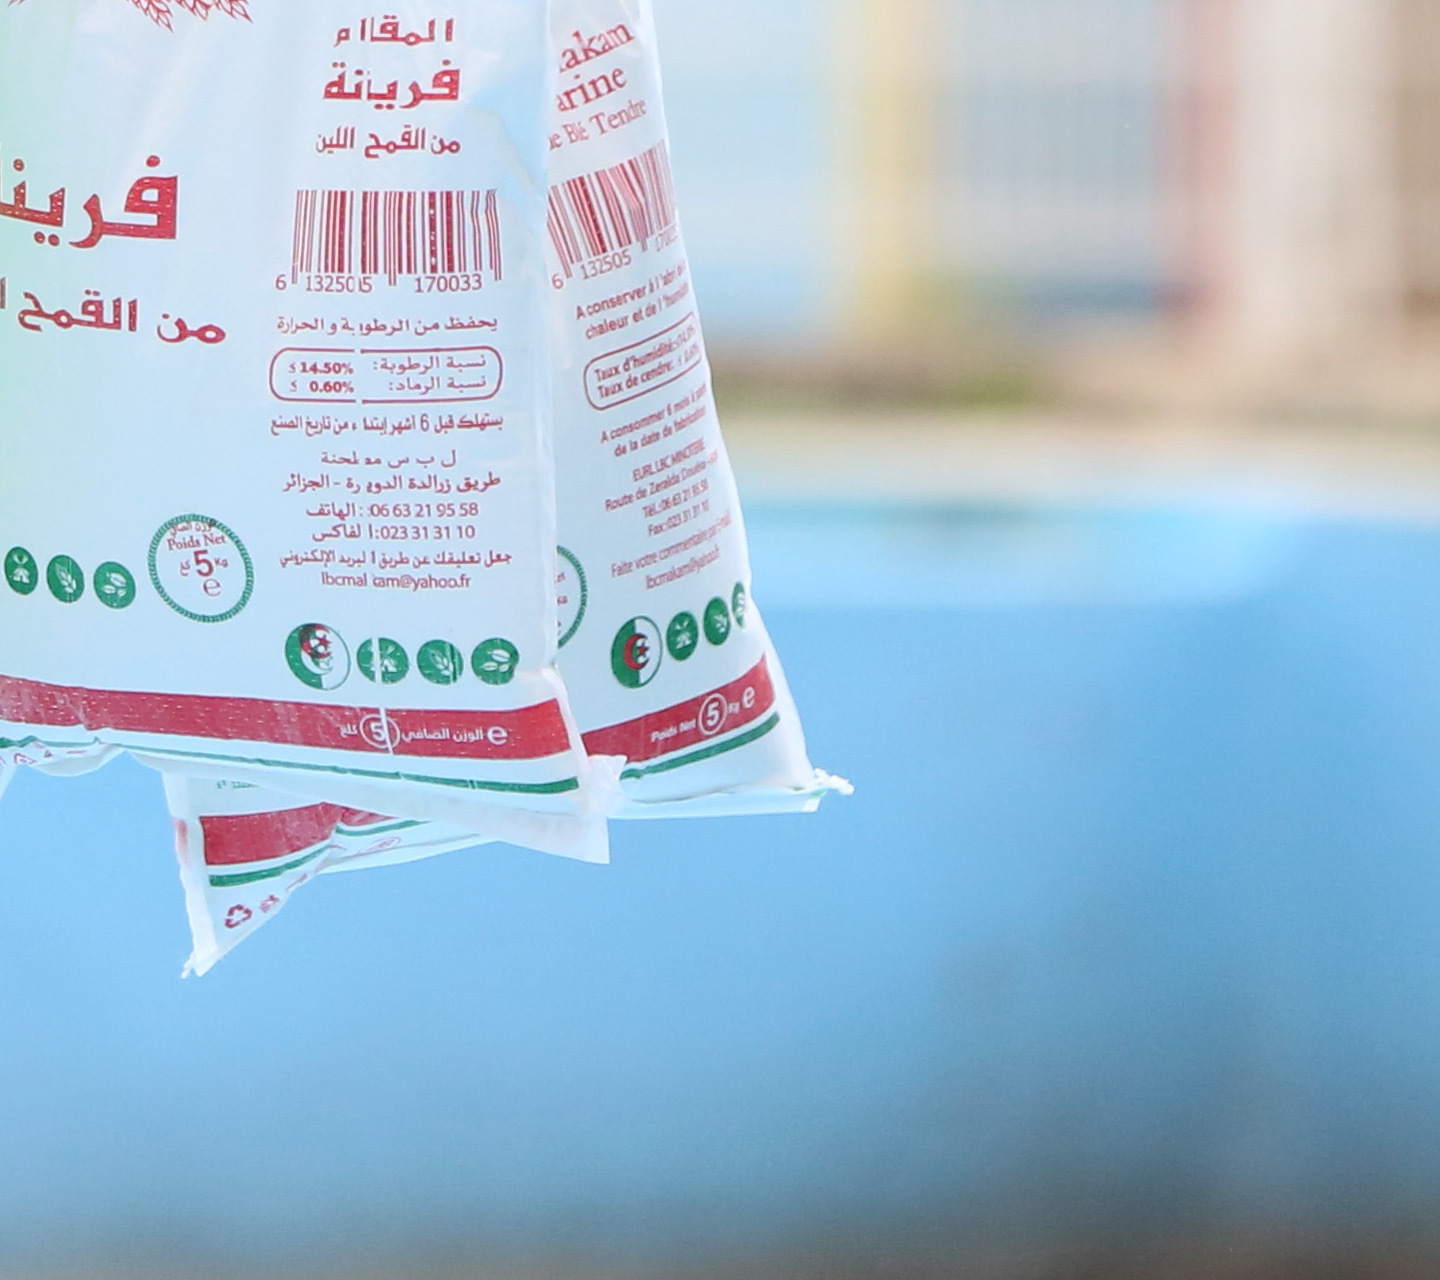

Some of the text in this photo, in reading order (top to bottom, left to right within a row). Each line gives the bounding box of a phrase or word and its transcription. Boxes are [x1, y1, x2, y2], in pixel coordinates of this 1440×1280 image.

[558, 23, 635, 74] akam
[589, 99, 647, 136] Tendre
[316, 124, 461, 159] من القمح اللين
[551, 273, 563, 290] 6
[580, 248, 632, 280] 132505
[275, 274, 287, 291] 6
[414, 274, 482, 293] 170033
[586, 283, 647, 317] conserver
[17, 289, 138, 333] القمح
[585, 314, 630, 339] chaleur
[632, 307, 644, 323] et
[645, 302, 656, 317] de
[157, 312, 226, 344] من
[276, 316, 324, 335] الحرارة
[414, 320, 439, 336] من
[443, 317, 498, 333] يحفظ
[594, 365, 620, 383] Taux
[626, 374, 639, 390] de
[309, 381, 355, 395] 0.60%
[420, 412, 430, 432] 6
[610, 408, 666, 441] consommer
[614, 443, 627, 458] de
[387, 455, 409, 469] س
[283, 472, 329, 493] الجزائر
[456, 471, 501, 493] طريق
[392, 503, 411, 518] 63
[414, 503, 432, 518] 21
[436, 502, 456, 518] 95
[459, 502, 479, 517] 58
[605, 493, 634, 512] Route
[635, 487, 647, 501] de
[166, 532, 226, 551] Poids Net
[412, 525, 429, 540] 31
[433, 525, 451, 540] 31
[457, 525, 476, 539] 10
[193, 549, 214, 577] 5
[706, 701, 720, 727] 5
[369, 721, 387, 742] 5
